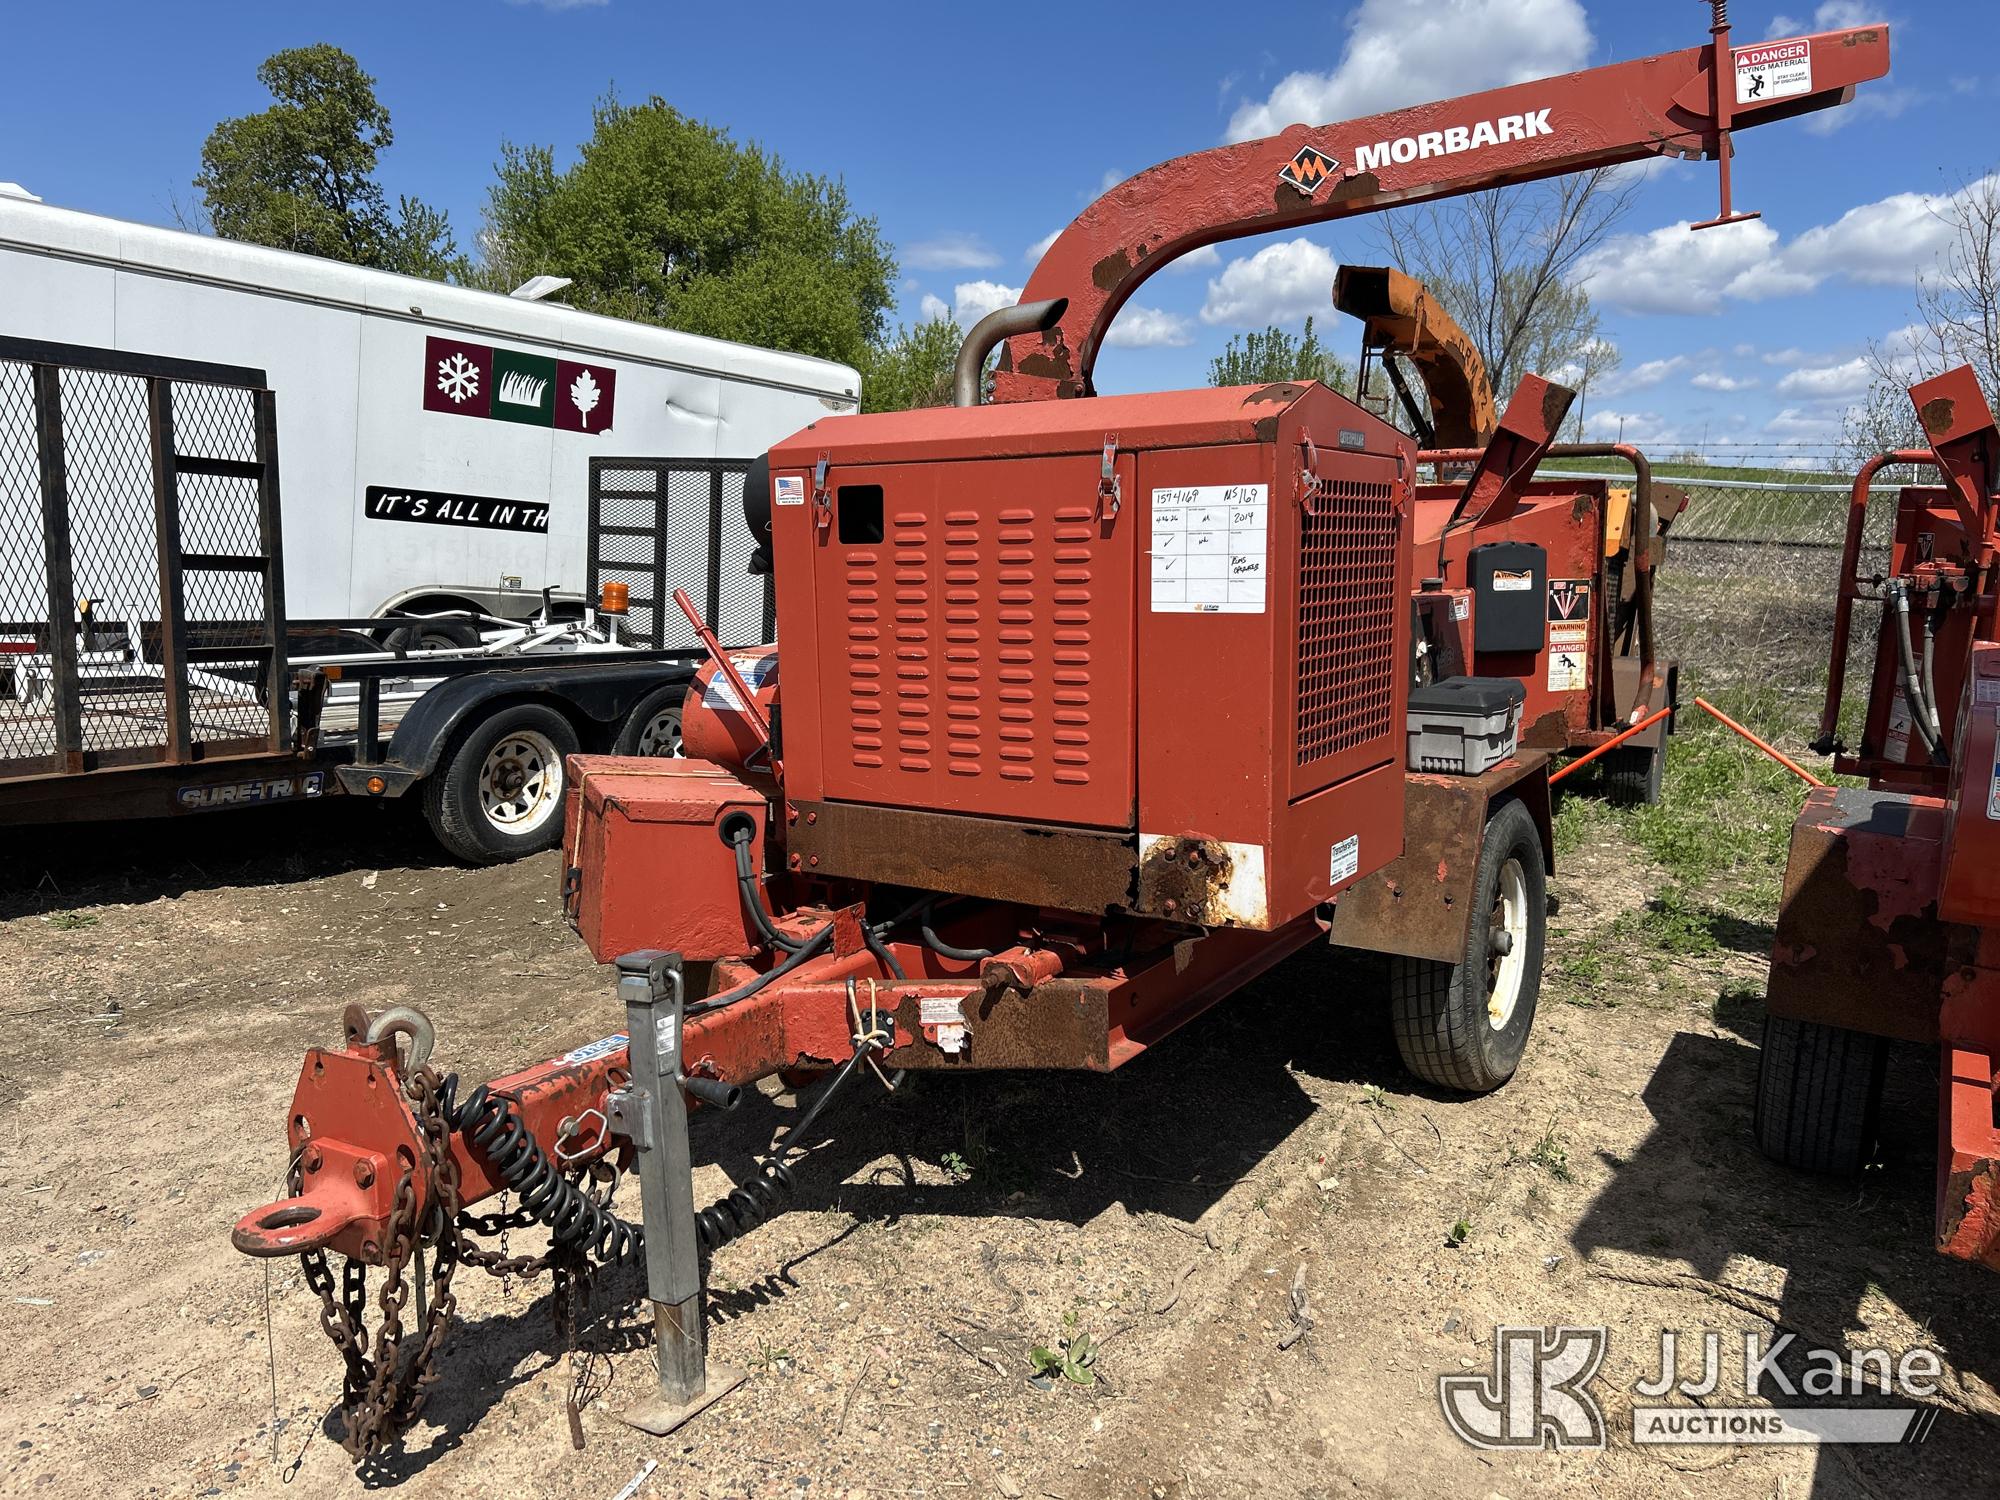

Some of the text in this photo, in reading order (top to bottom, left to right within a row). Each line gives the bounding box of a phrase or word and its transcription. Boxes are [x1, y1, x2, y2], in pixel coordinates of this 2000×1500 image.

[1751, 45, 1805, 64] DANGER
[1738, 58, 1807, 75] FLYING MATERIAL
[1355, 108, 1553, 172] MORBARK
[375, 493, 550, 528] IT'S ALL IN TH
[1234, 511, 1254, 525] 2014
[1557, 644, 1585, 652] DANGER
